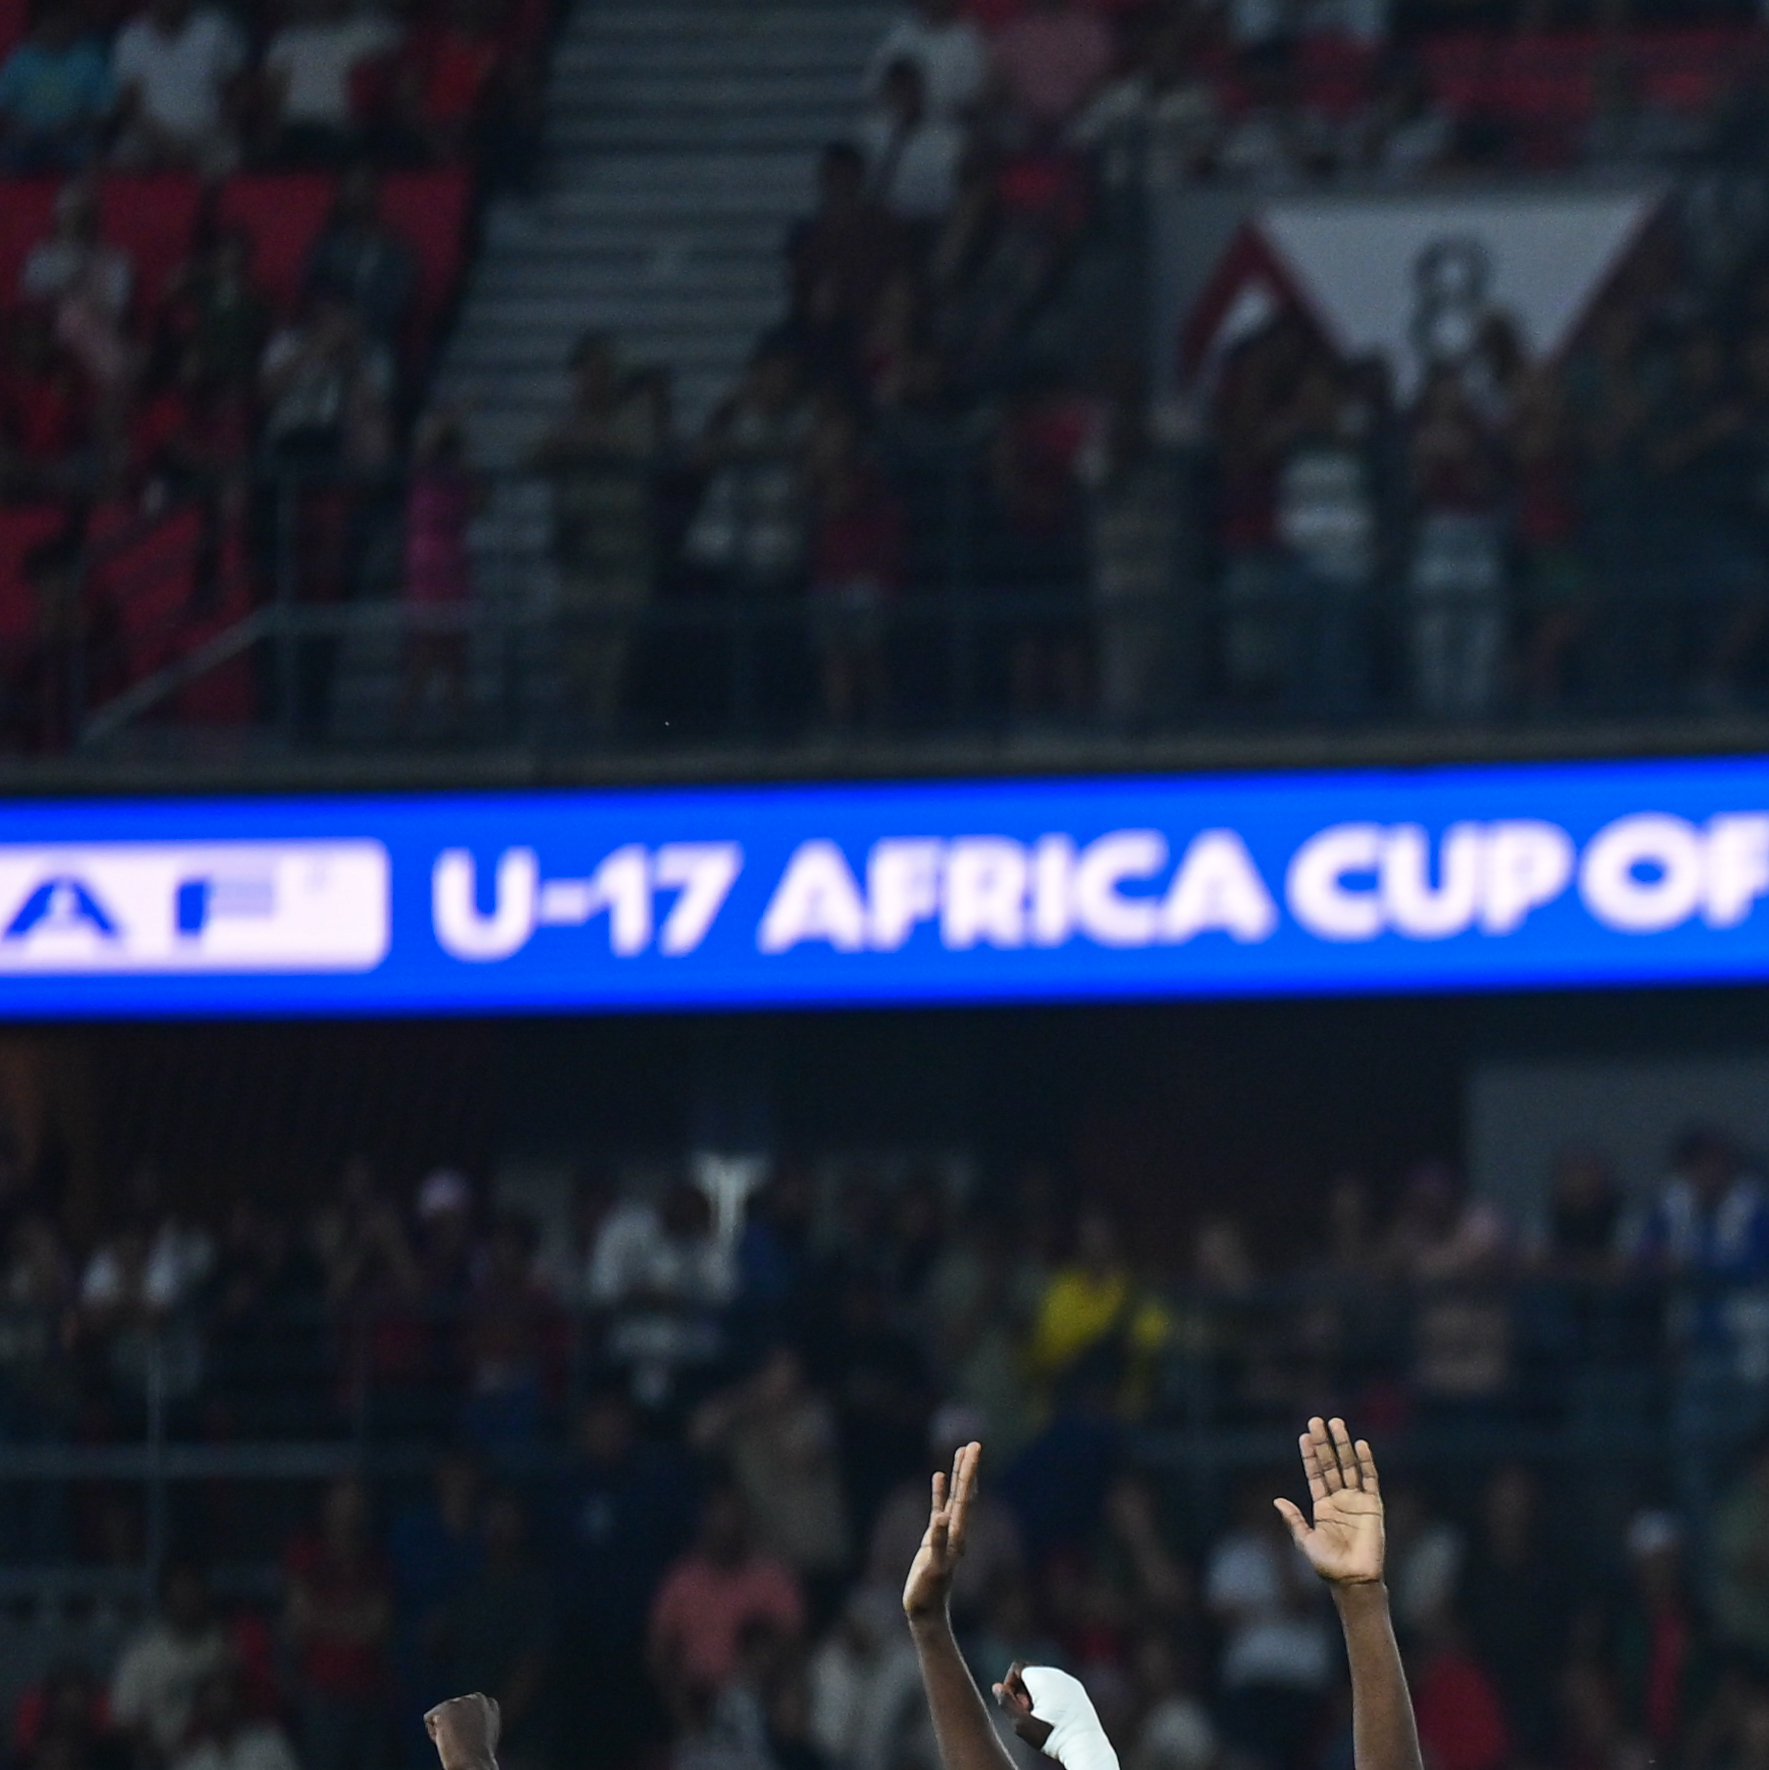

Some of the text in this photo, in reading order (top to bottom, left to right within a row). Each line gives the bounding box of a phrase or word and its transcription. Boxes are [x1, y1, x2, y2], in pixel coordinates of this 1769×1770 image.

[430, 842, 744, 963] U-17
[756, 830, 1278, 955] AFRICA
[1285, 819, 1577, 943] CUP
